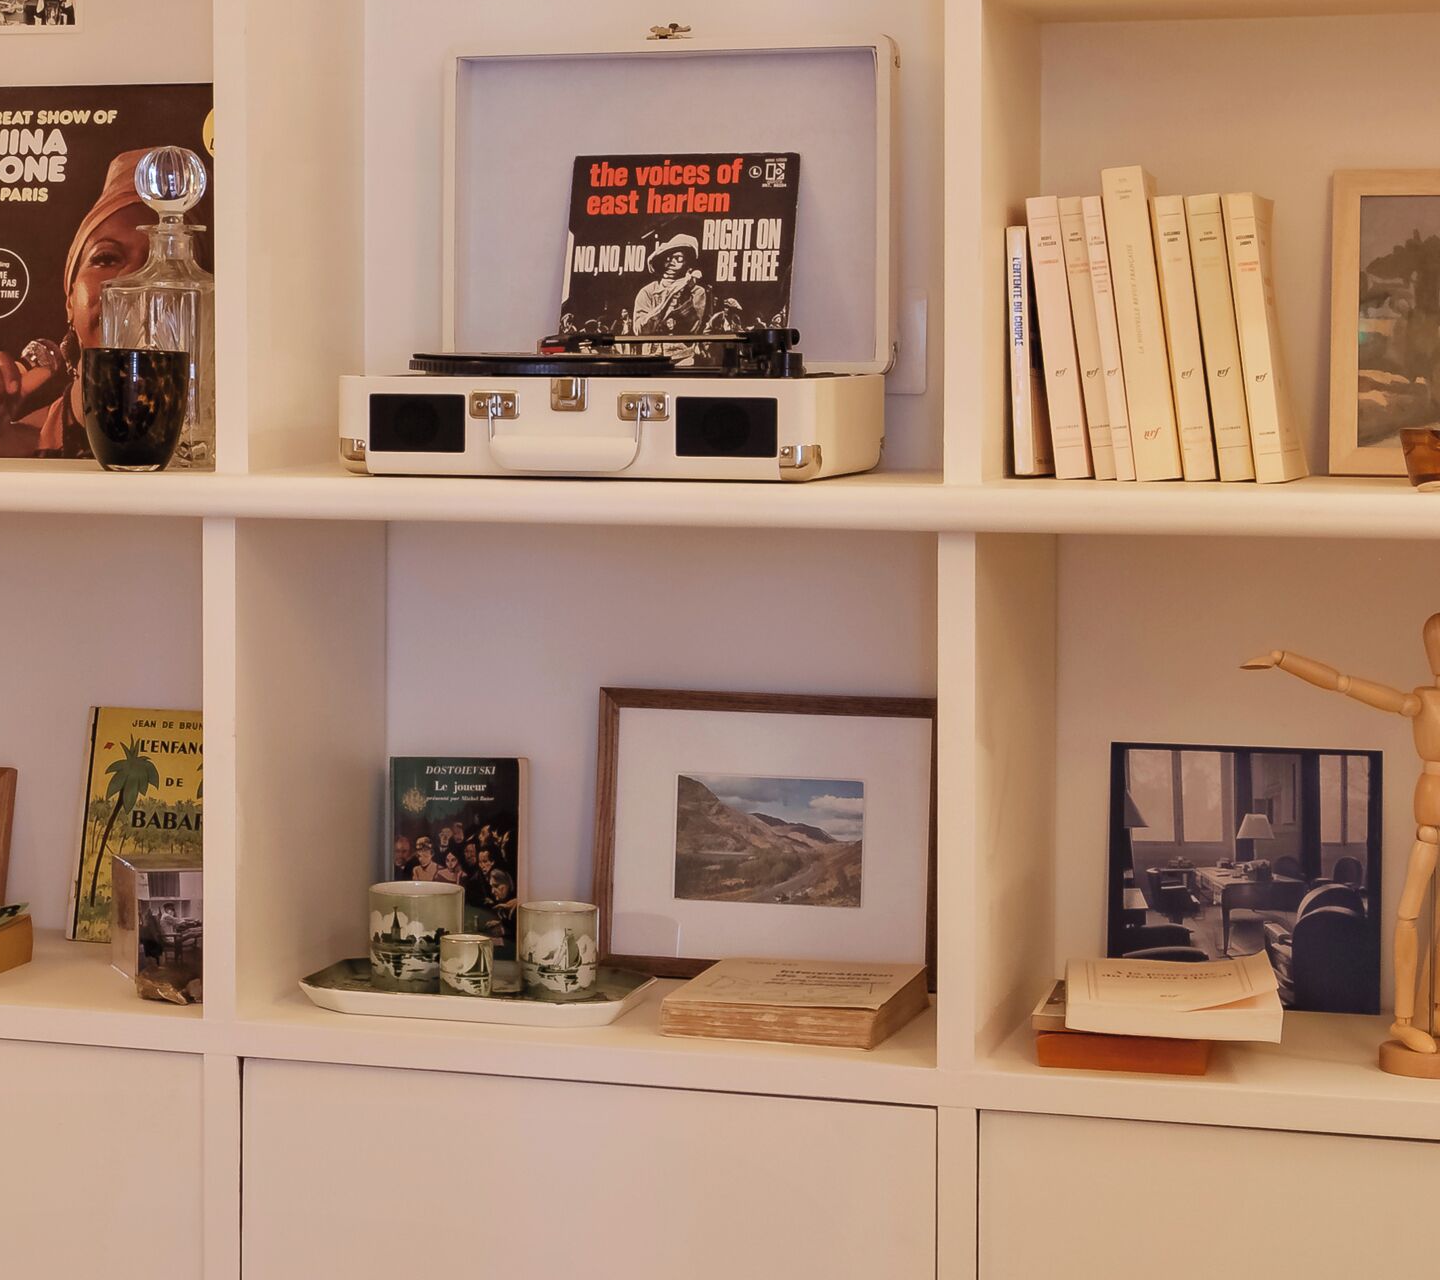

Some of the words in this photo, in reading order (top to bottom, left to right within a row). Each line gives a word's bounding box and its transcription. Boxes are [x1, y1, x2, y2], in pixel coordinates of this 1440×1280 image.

[36, 110, 91, 125] SHOW
[93, 109, 118, 124] OF
[590, 161, 628, 187] the
[635, 159, 710, 187] voices
[716, 157, 743, 185] of
[0, 187, 48, 202] PARIS
[586, 190, 639, 216] east
[646, 187, 730, 214] harlem
[702, 219, 754, 250] RIGHT
[756, 218, 782, 250] ON
[573, 244, 646, 276] NO,NO,NO
[716, 250, 738, 282] BE
[741, 250, 780, 282] FREE
[1, 279, 17, 287] PAS
[0, 290, 20, 298] TIME
[1013, 301, 1022, 313] DU
[1014, 315, 1023, 346] COUPLE
[132, 720, 156, 728] JEAN
[162, 721, 174, 729] DE
[426, 765, 496, 775] DOSTOIEVSKI
[165, 778, 183, 787] DE
[435, 781, 448, 792] Le
[453, 781, 487, 794] joueur
